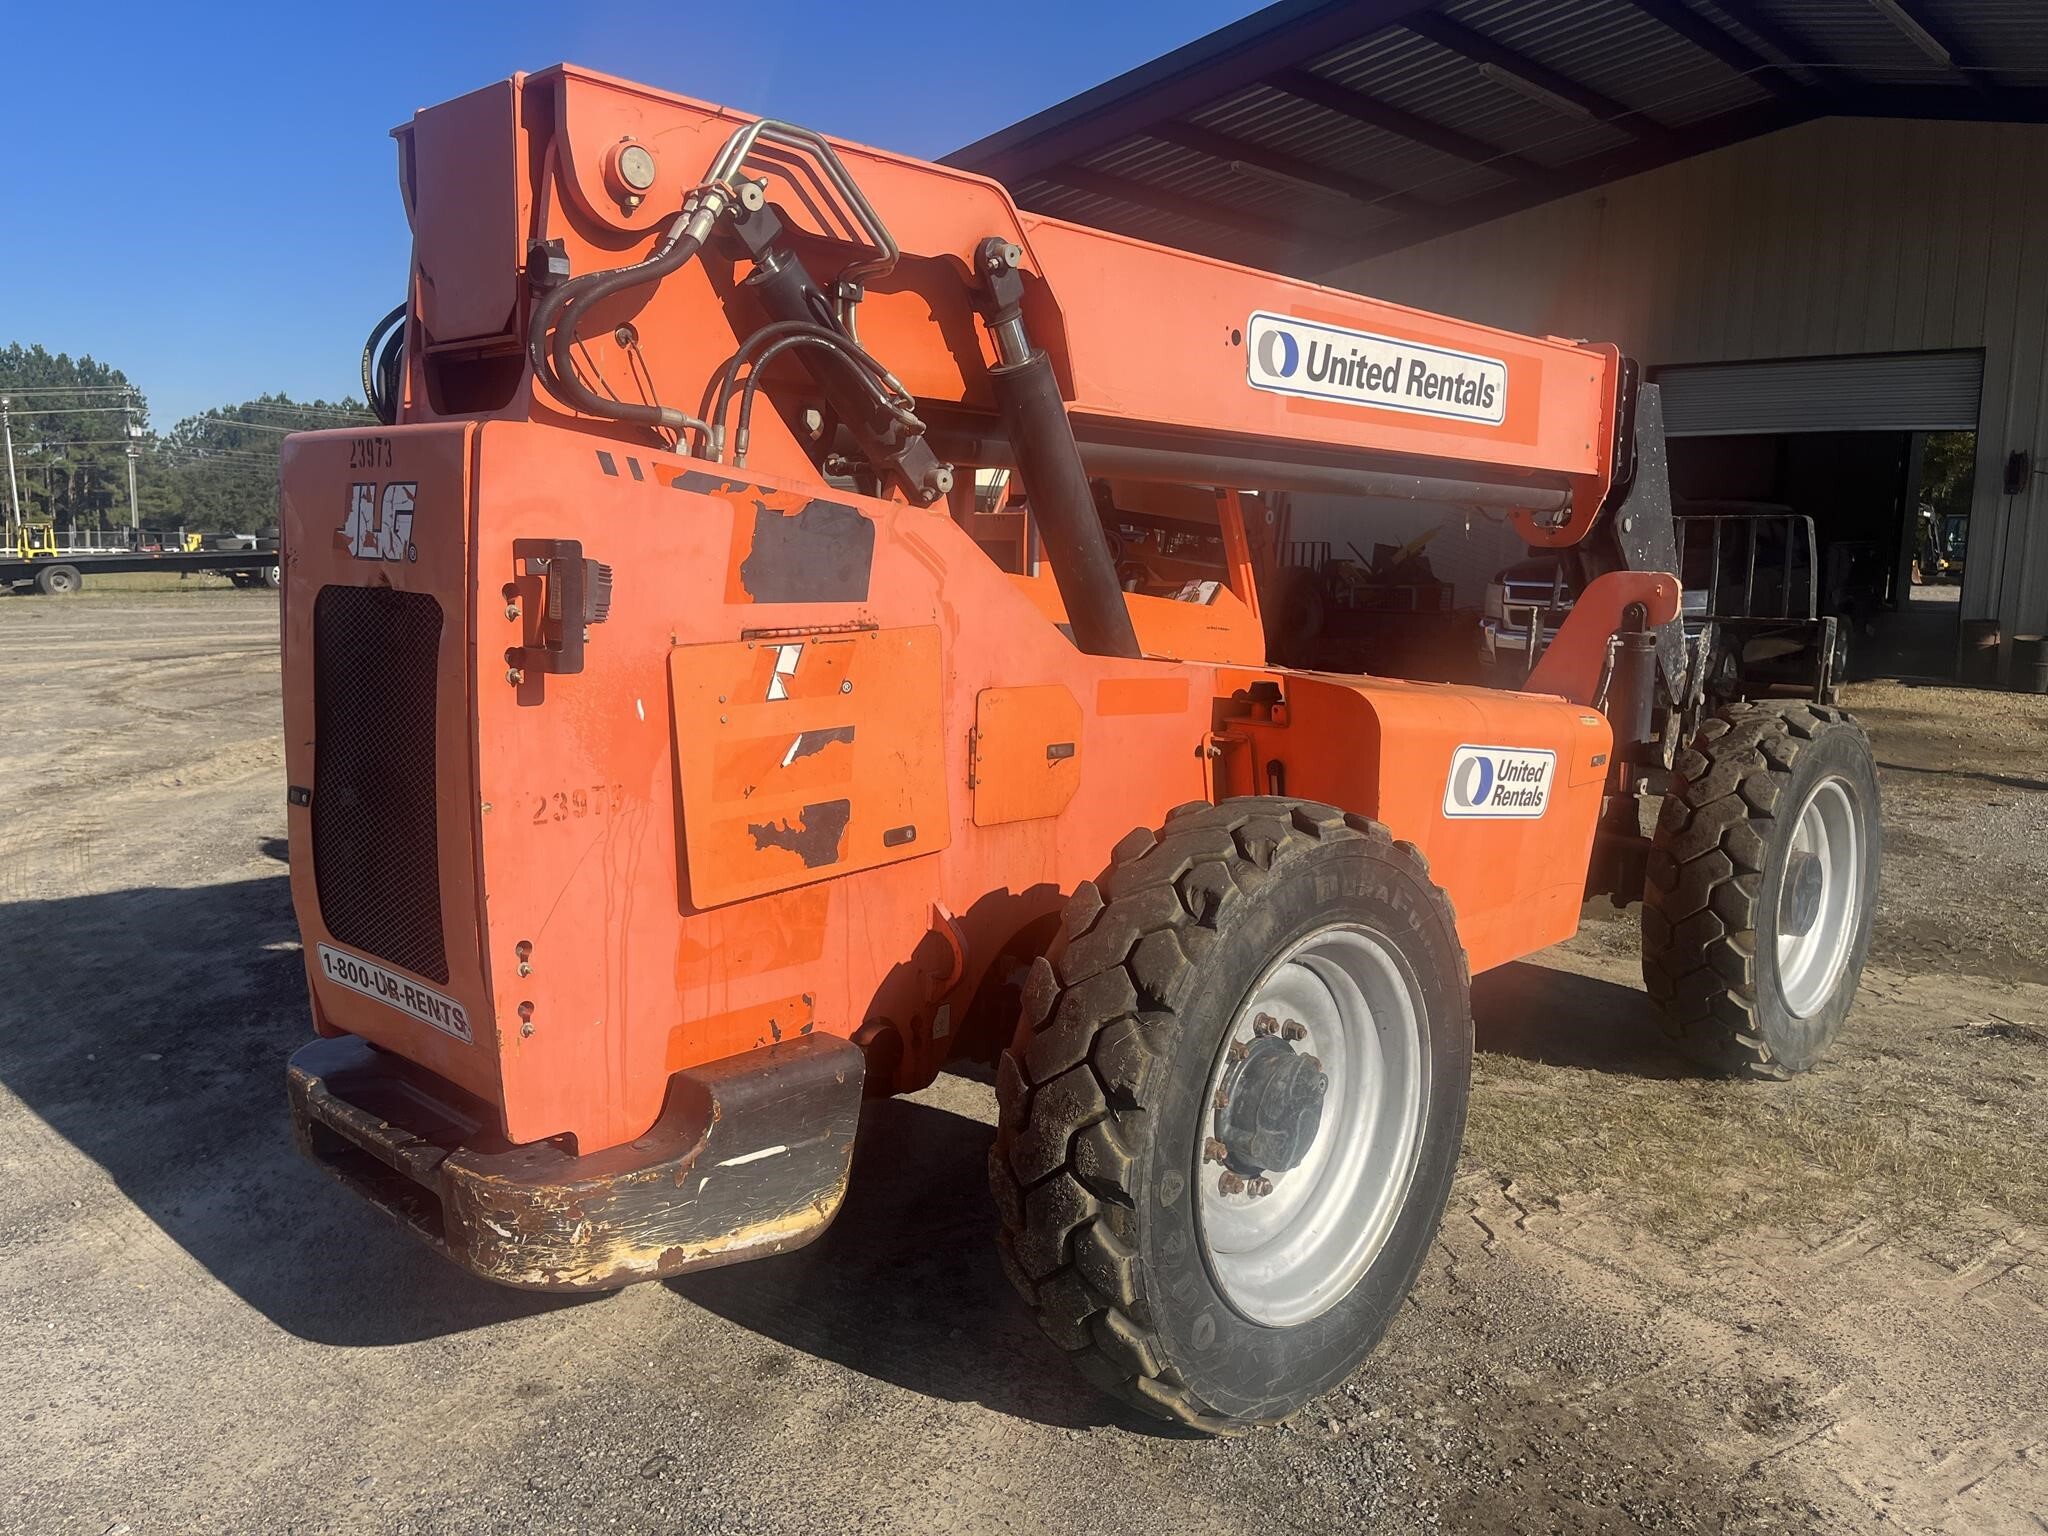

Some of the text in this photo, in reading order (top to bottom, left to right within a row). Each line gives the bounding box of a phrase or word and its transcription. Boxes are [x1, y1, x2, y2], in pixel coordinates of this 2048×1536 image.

[1306, 340, 1496, 410] United Rentals
[350, 437, 393, 469] 23973
[1497, 759, 1544, 783] United
[1490, 784, 1544, 808] Rentals
